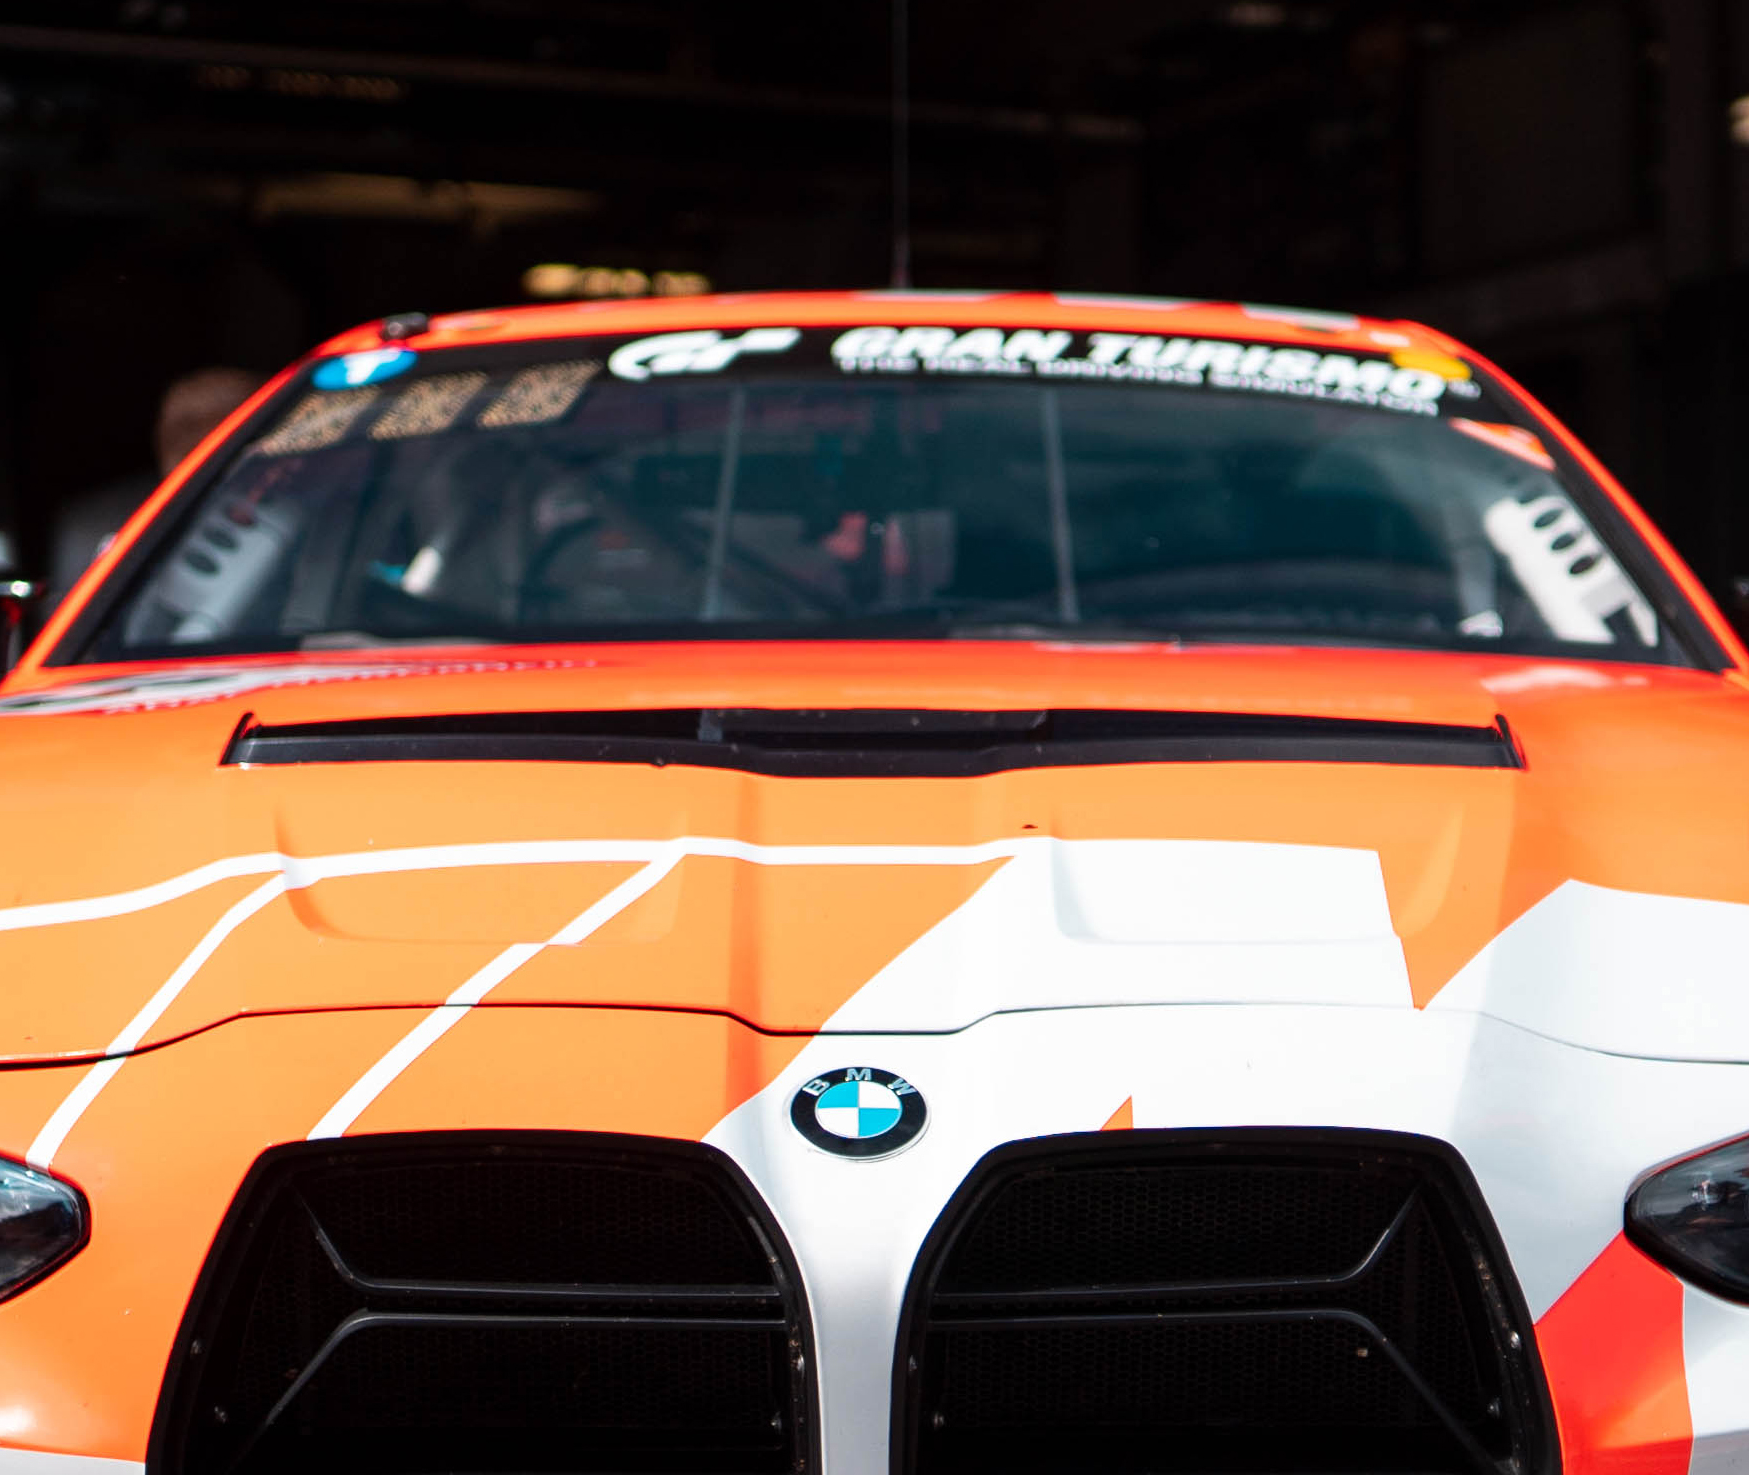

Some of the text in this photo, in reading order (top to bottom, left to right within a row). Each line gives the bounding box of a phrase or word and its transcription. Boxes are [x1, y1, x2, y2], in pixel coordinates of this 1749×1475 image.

[831, 326, 1447, 400] GRAN TURISMO
[839, 356, 919, 373] THE
[922, 356, 1033, 374] REAL
[1207, 369, 1439, 417] SIMULATOR
[802, 1068, 919, 1097] BMW
